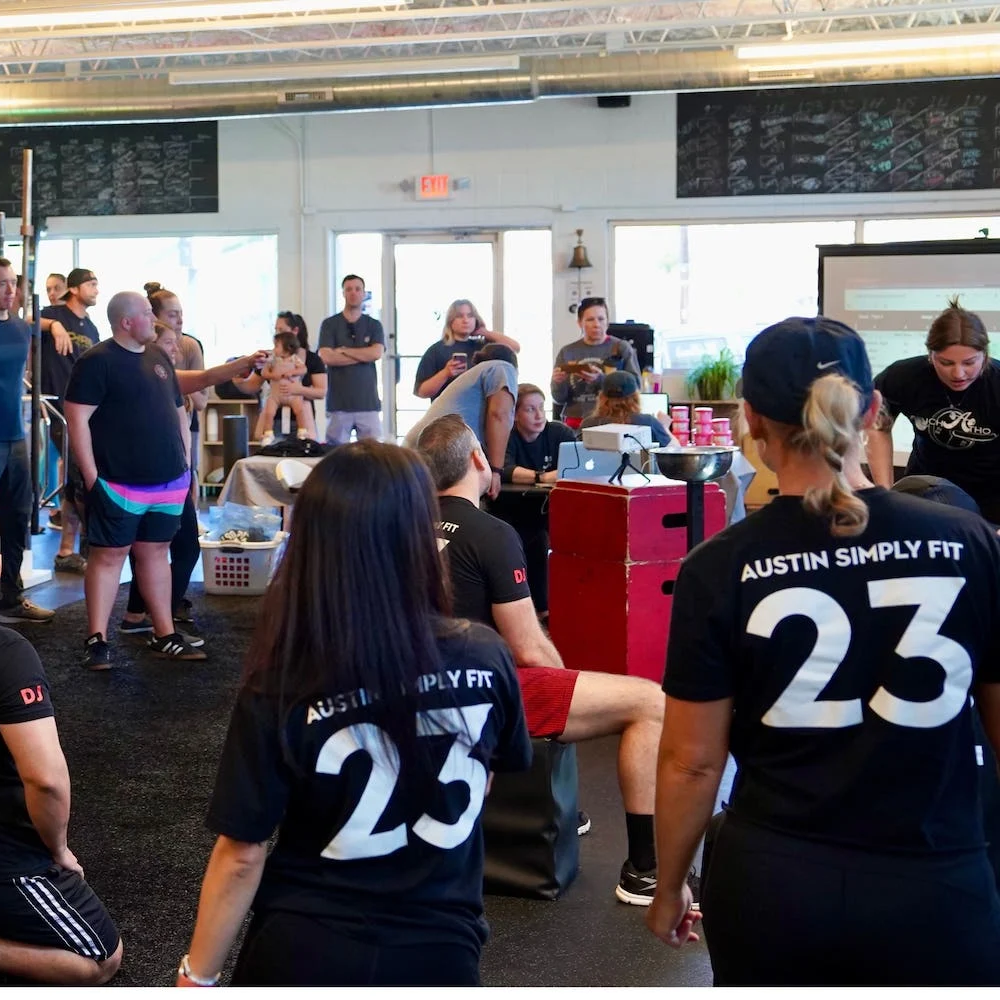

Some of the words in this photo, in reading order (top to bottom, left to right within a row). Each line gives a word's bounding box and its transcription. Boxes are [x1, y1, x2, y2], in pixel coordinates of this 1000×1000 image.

[421, 175, 449, 193] EXIT
[442, 521, 460, 533] FIT
[740, 550, 829, 583] AUSTIN
[835, 540, 922, 567] SIMPLY
[927, 540, 964, 562] FIT
[746, 576, 973, 729] 23
[466, 669, 494, 688] FIT
[20, 685, 45, 705] DJ
[315, 703, 493, 861] 23
